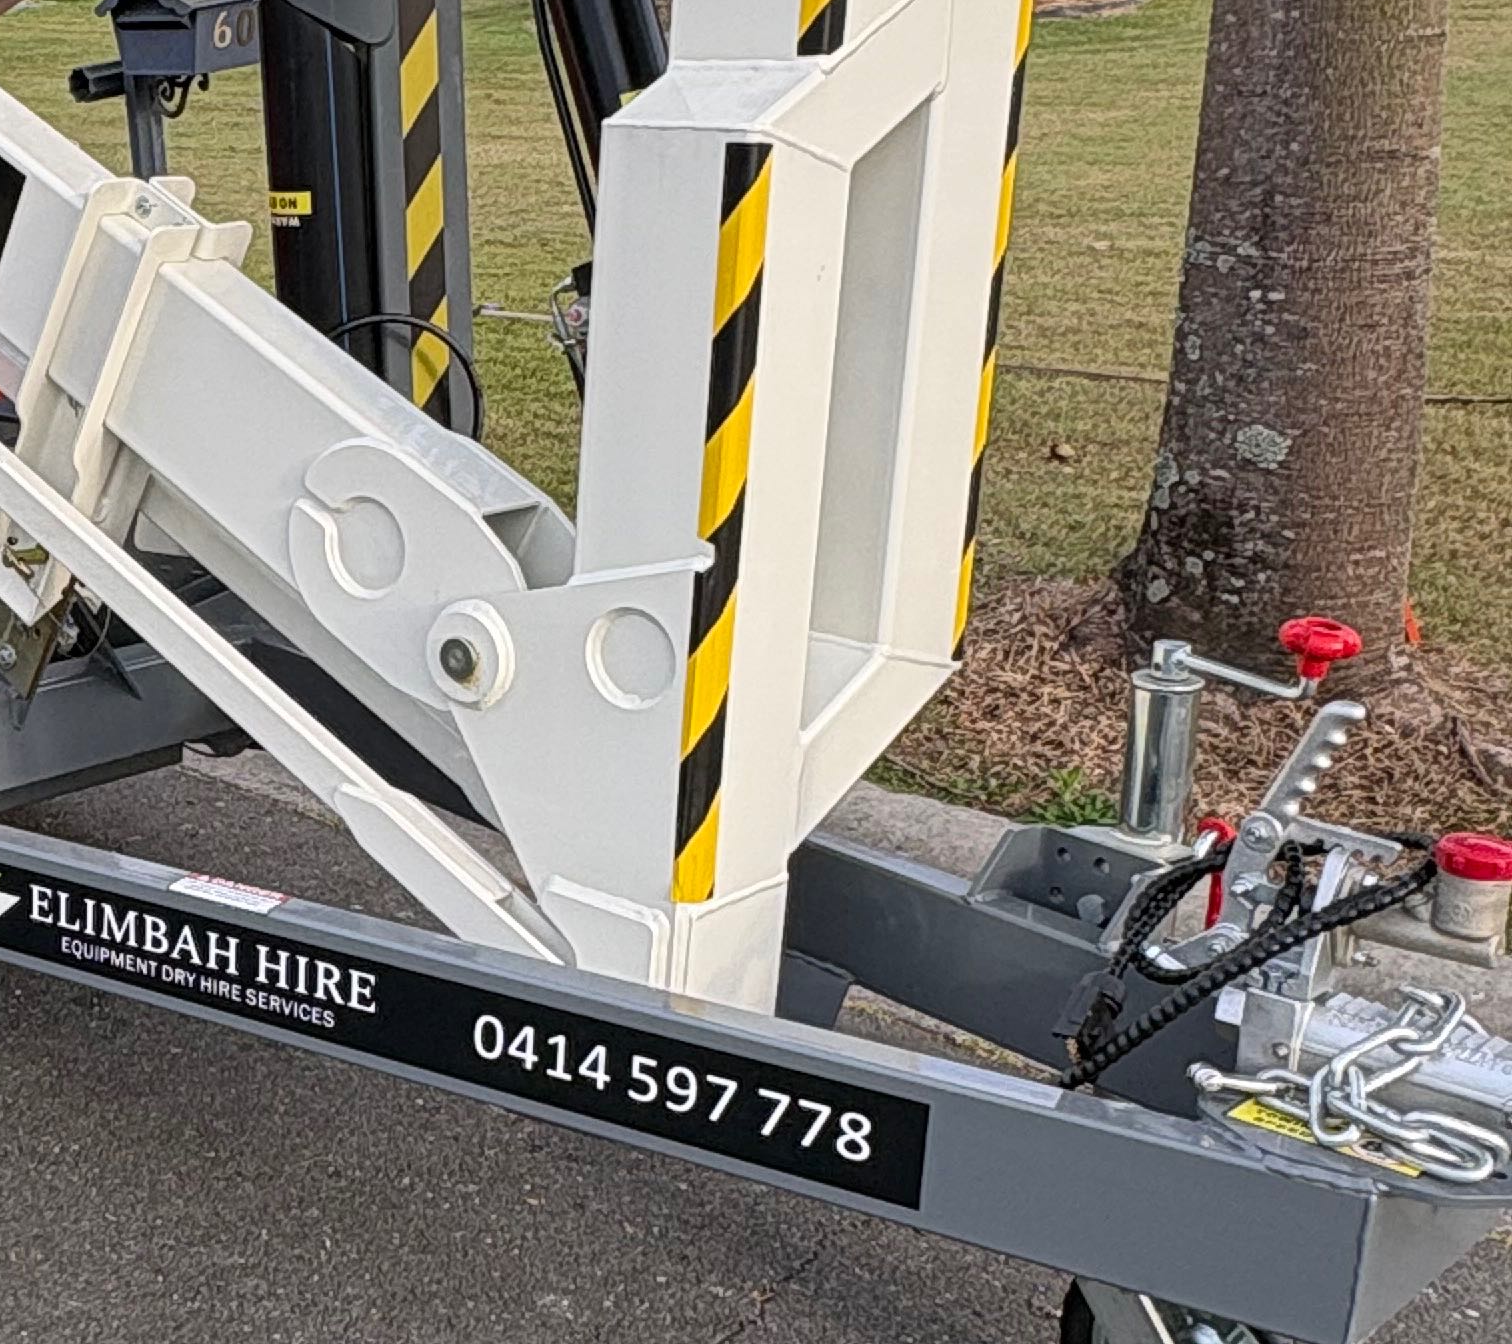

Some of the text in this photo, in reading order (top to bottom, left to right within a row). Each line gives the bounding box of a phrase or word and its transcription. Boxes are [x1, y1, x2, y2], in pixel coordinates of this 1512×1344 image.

[29, 884, 240, 976] ELIMBAH
[255, 944, 377, 1014] HIRE
[61, 936, 336, 1029] EQUIPMENT DRY HIRE SERVICES
[473, 1014, 873, 1162] 0414 597 778
